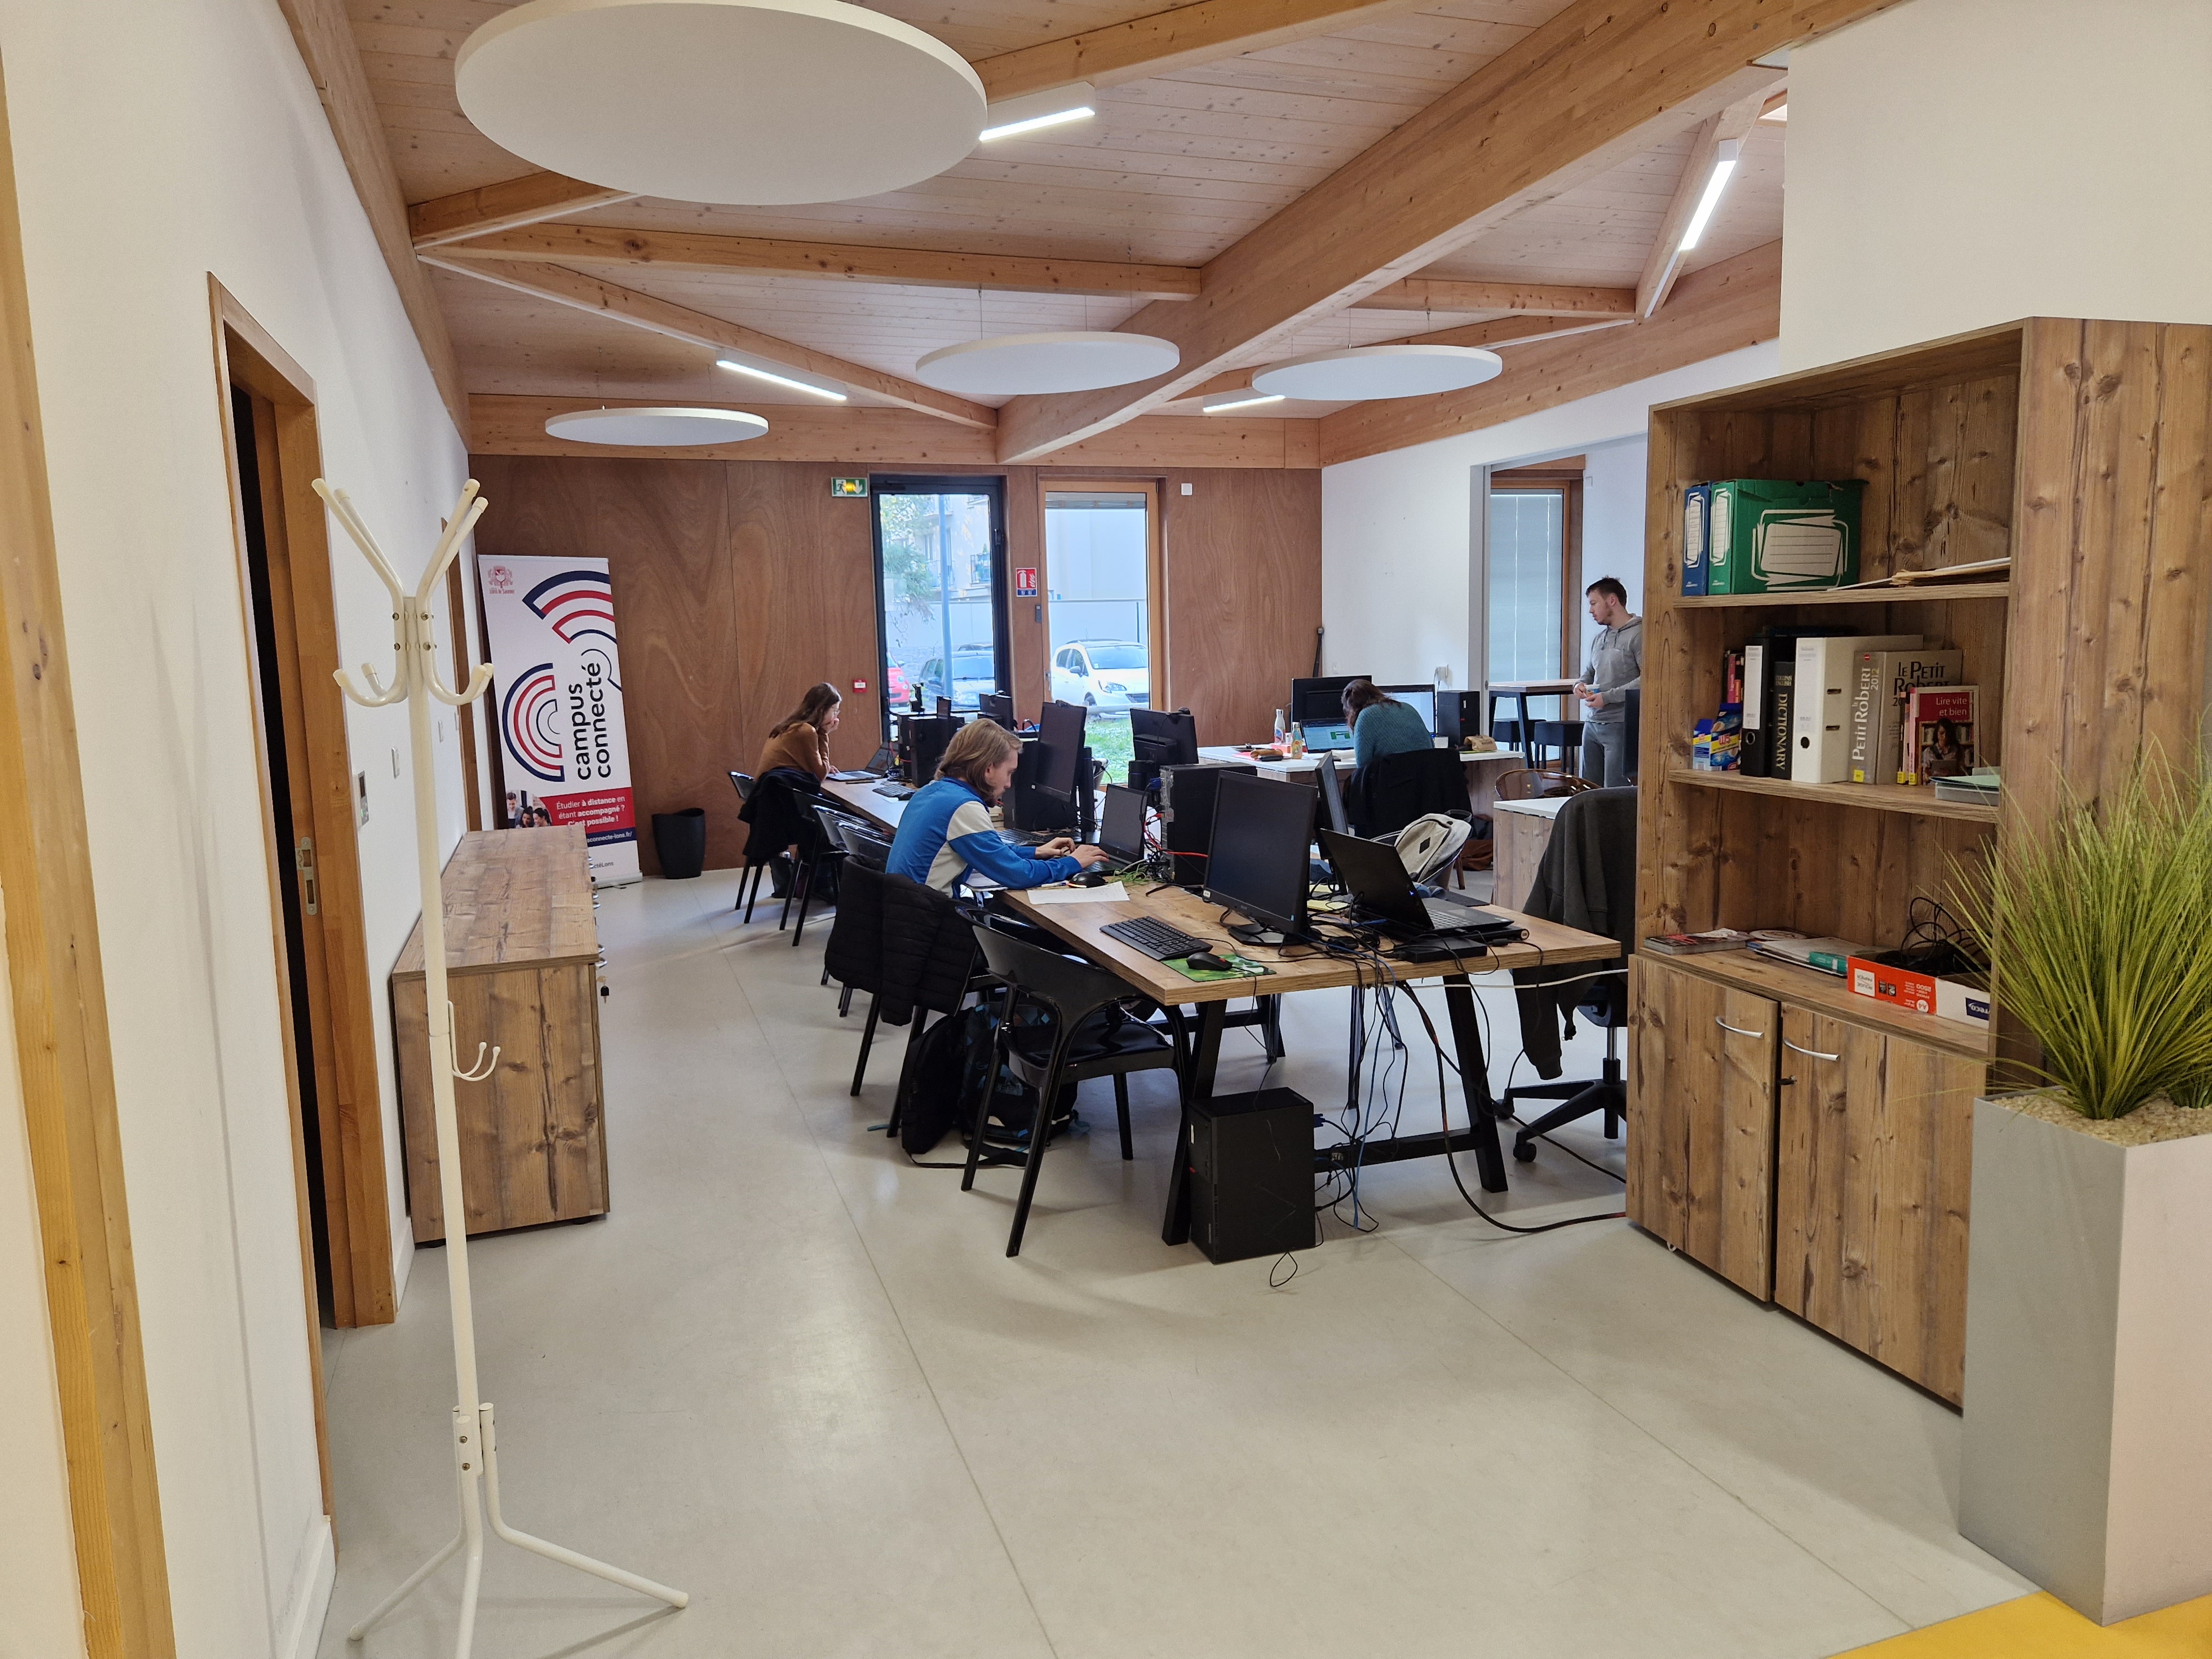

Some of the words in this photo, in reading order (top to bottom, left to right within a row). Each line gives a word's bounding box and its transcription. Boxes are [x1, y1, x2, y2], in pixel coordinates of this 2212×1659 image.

[1870, 667, 1879, 691] 2012
[1949, 707, 1967, 716] bien
[581, 662, 612, 778] connecté
[568, 683, 591, 780] campus
[1776, 693, 1788, 770] DICTIONARY
[556, 801, 580, 810] Étudier
[588, 797, 616, 805] distance
[578, 805, 620, 816] accompagné
[587, 816, 615, 827] possible
[587, 831, 633, 843] sconnecte-lons.fr/
[1971, 1004, 1990, 1014] reco
